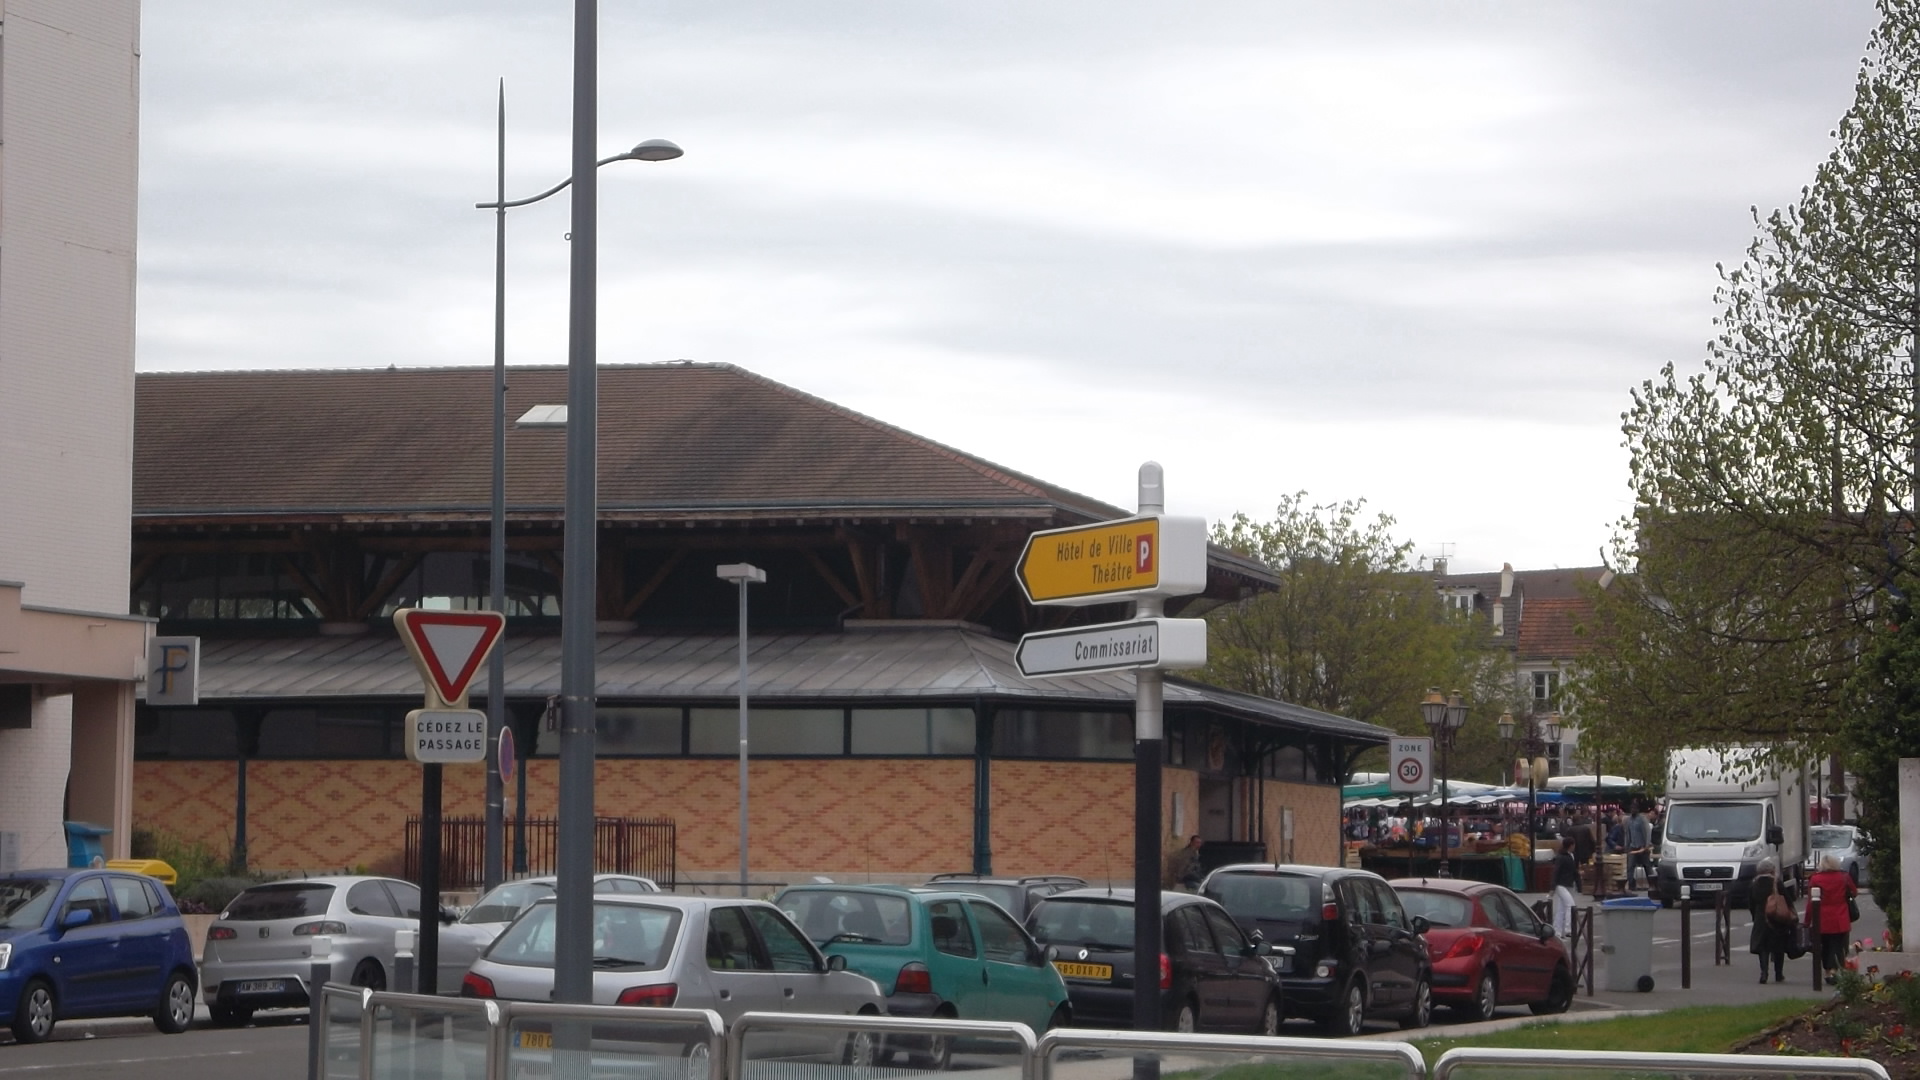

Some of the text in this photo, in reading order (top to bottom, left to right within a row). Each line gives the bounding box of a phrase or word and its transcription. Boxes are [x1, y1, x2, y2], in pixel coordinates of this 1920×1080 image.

[1057, 533, 1133, 562] Hôtel de Ville
[1140, 540, 1150, 568] P
[1092, 562, 1133, 584] Théâtre
[1075, 633, 1153, 661] Commissariat
[468, 722, 483, 733] LE
[419, 739, 481, 750] PASSAGE
[1399, 744, 1423, 752] ZONE
[1403, 765, 1418, 776] 30
